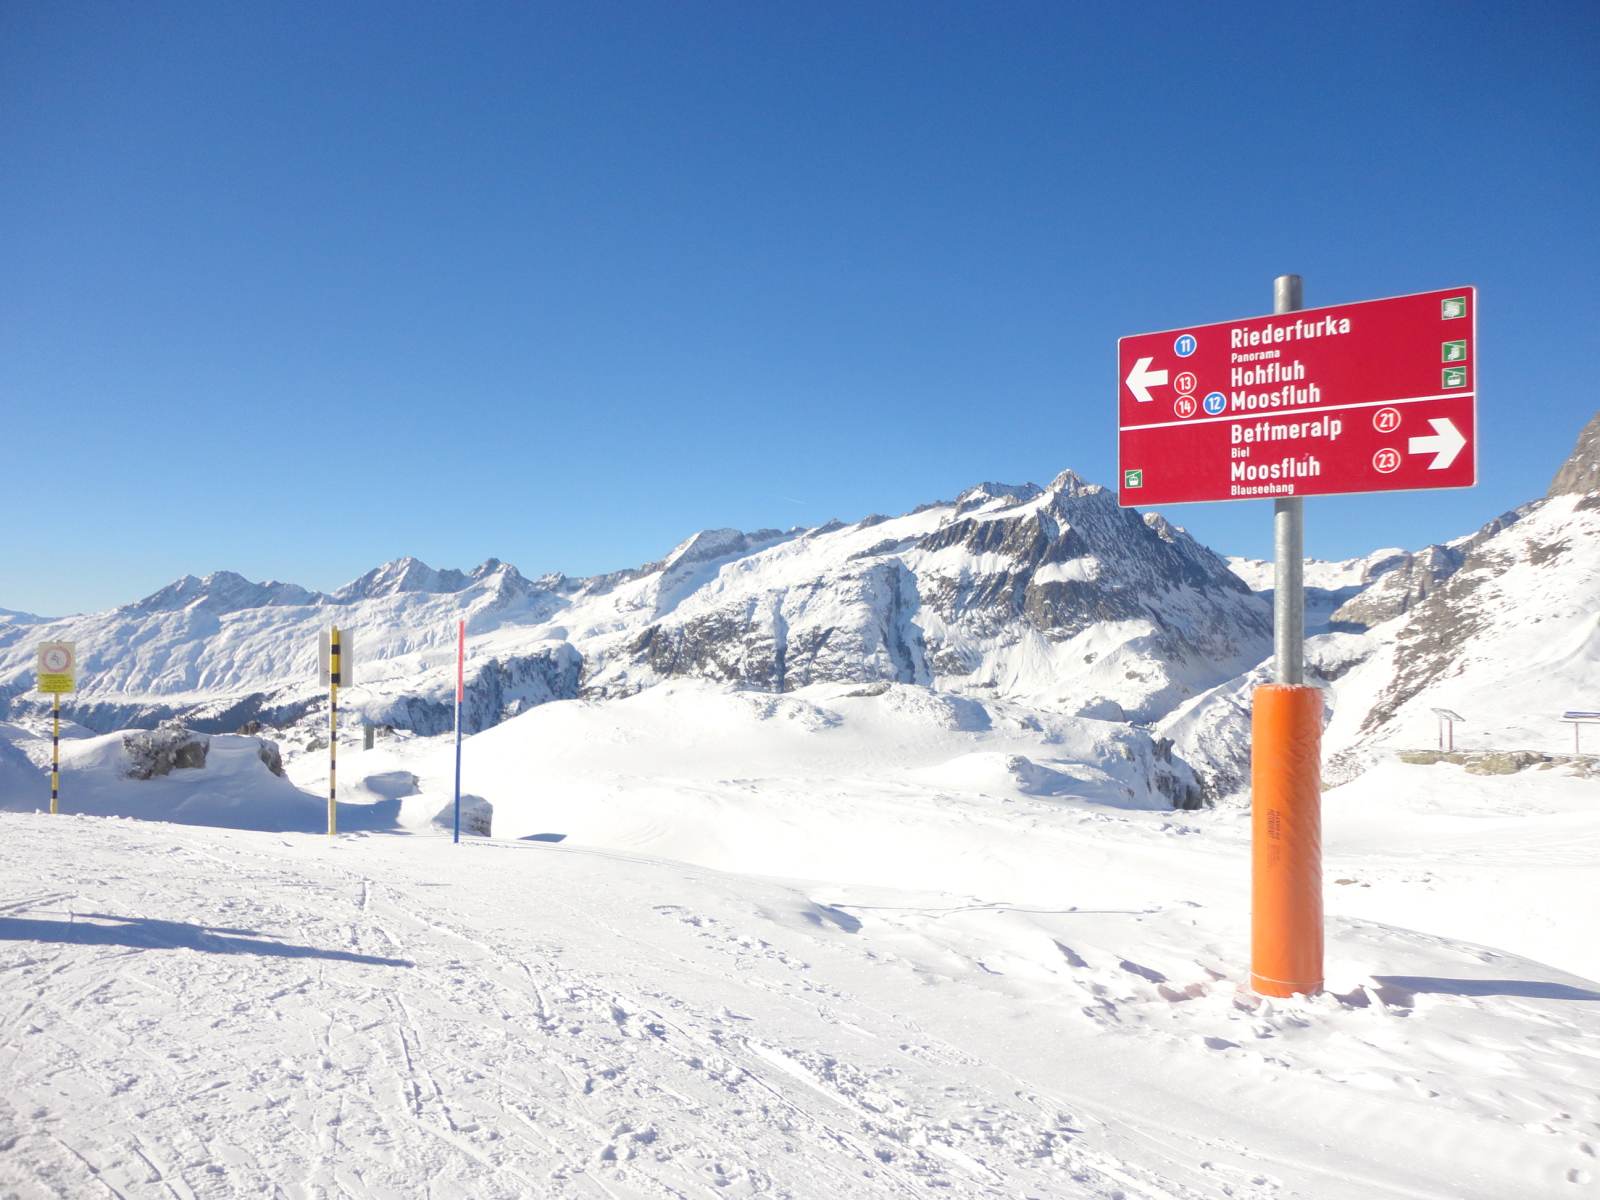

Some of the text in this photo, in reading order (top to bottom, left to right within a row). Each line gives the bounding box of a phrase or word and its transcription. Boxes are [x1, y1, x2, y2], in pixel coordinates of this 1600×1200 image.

[1231, 316, 1351, 349] Riederfurka
[1180, 338, 1192, 353] 11
[1231, 349, 1281, 363] Panorama
[1231, 361, 1305, 387] Hohfluh
[1179, 375, 1192, 391] 13
[1178, 395, 1221, 414] 14 12
[1231, 384, 1321, 411] Moosfluh
[1379, 412, 1395, 428] 21
[1231, 418, 1342, 444] Bettmeralp
[1231, 447, 1250, 458] Biel
[1378, 452, 1396, 469] 23
[1231, 456, 1321, 482] Moosfluh
[1231, 483, 1295, 496] Blauseehang
